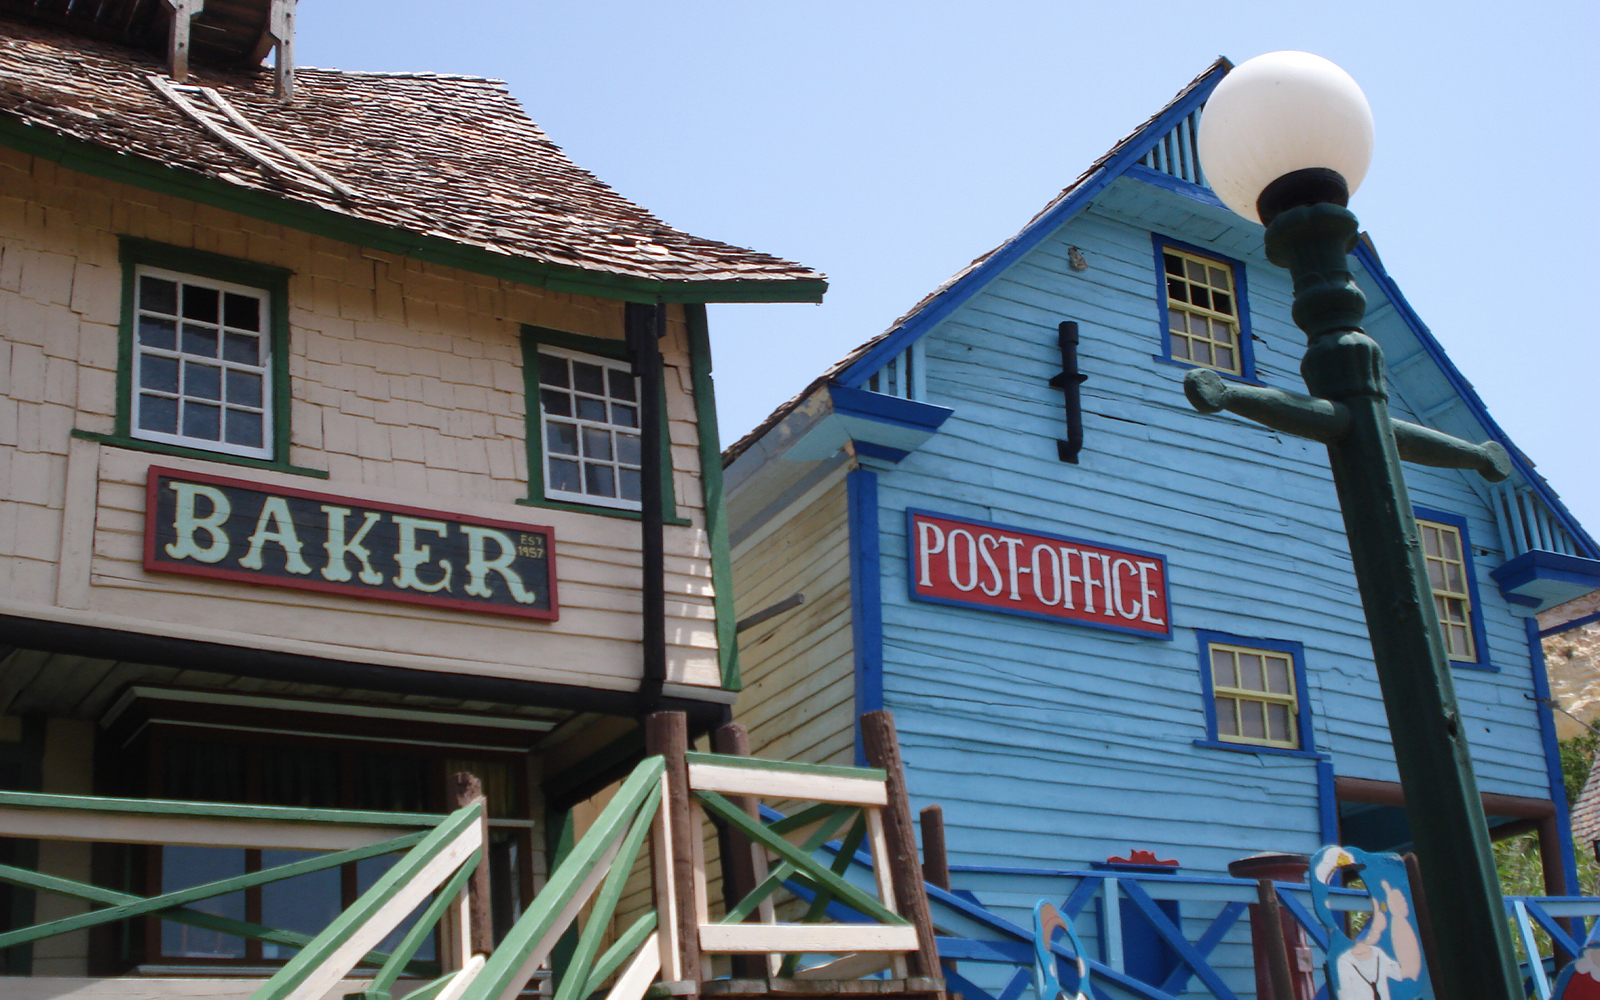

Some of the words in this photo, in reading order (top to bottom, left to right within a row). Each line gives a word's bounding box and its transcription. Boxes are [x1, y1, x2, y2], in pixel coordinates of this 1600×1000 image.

[164, 481, 536, 604] BAKER
[518, 545, 544, 559] 1957
[520, 534, 543, 546] EST
[917, 521, 1165, 626] POST-OFFICE
